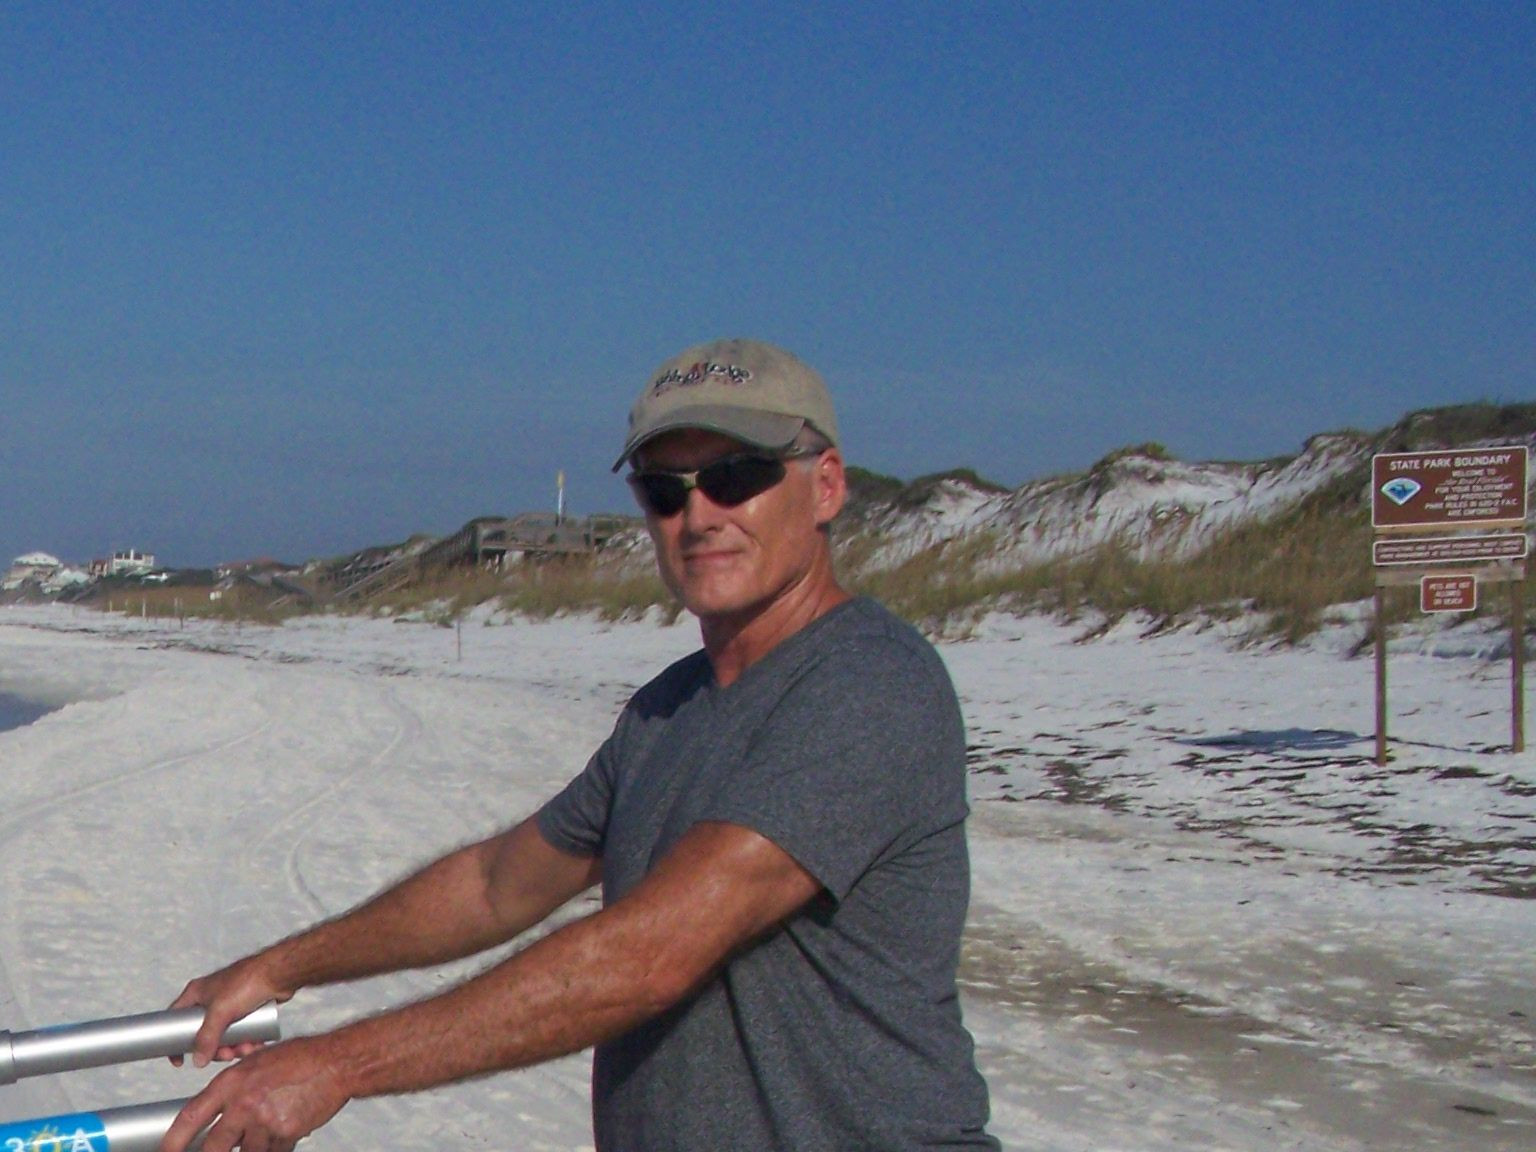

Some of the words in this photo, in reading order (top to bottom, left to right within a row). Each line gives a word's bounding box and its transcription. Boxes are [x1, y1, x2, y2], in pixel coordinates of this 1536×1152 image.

[1389, 459, 1420, 471] STATE
[1423, 457, 1451, 469] PARK
[1454, 454, 1511, 467] BOUNDARY
